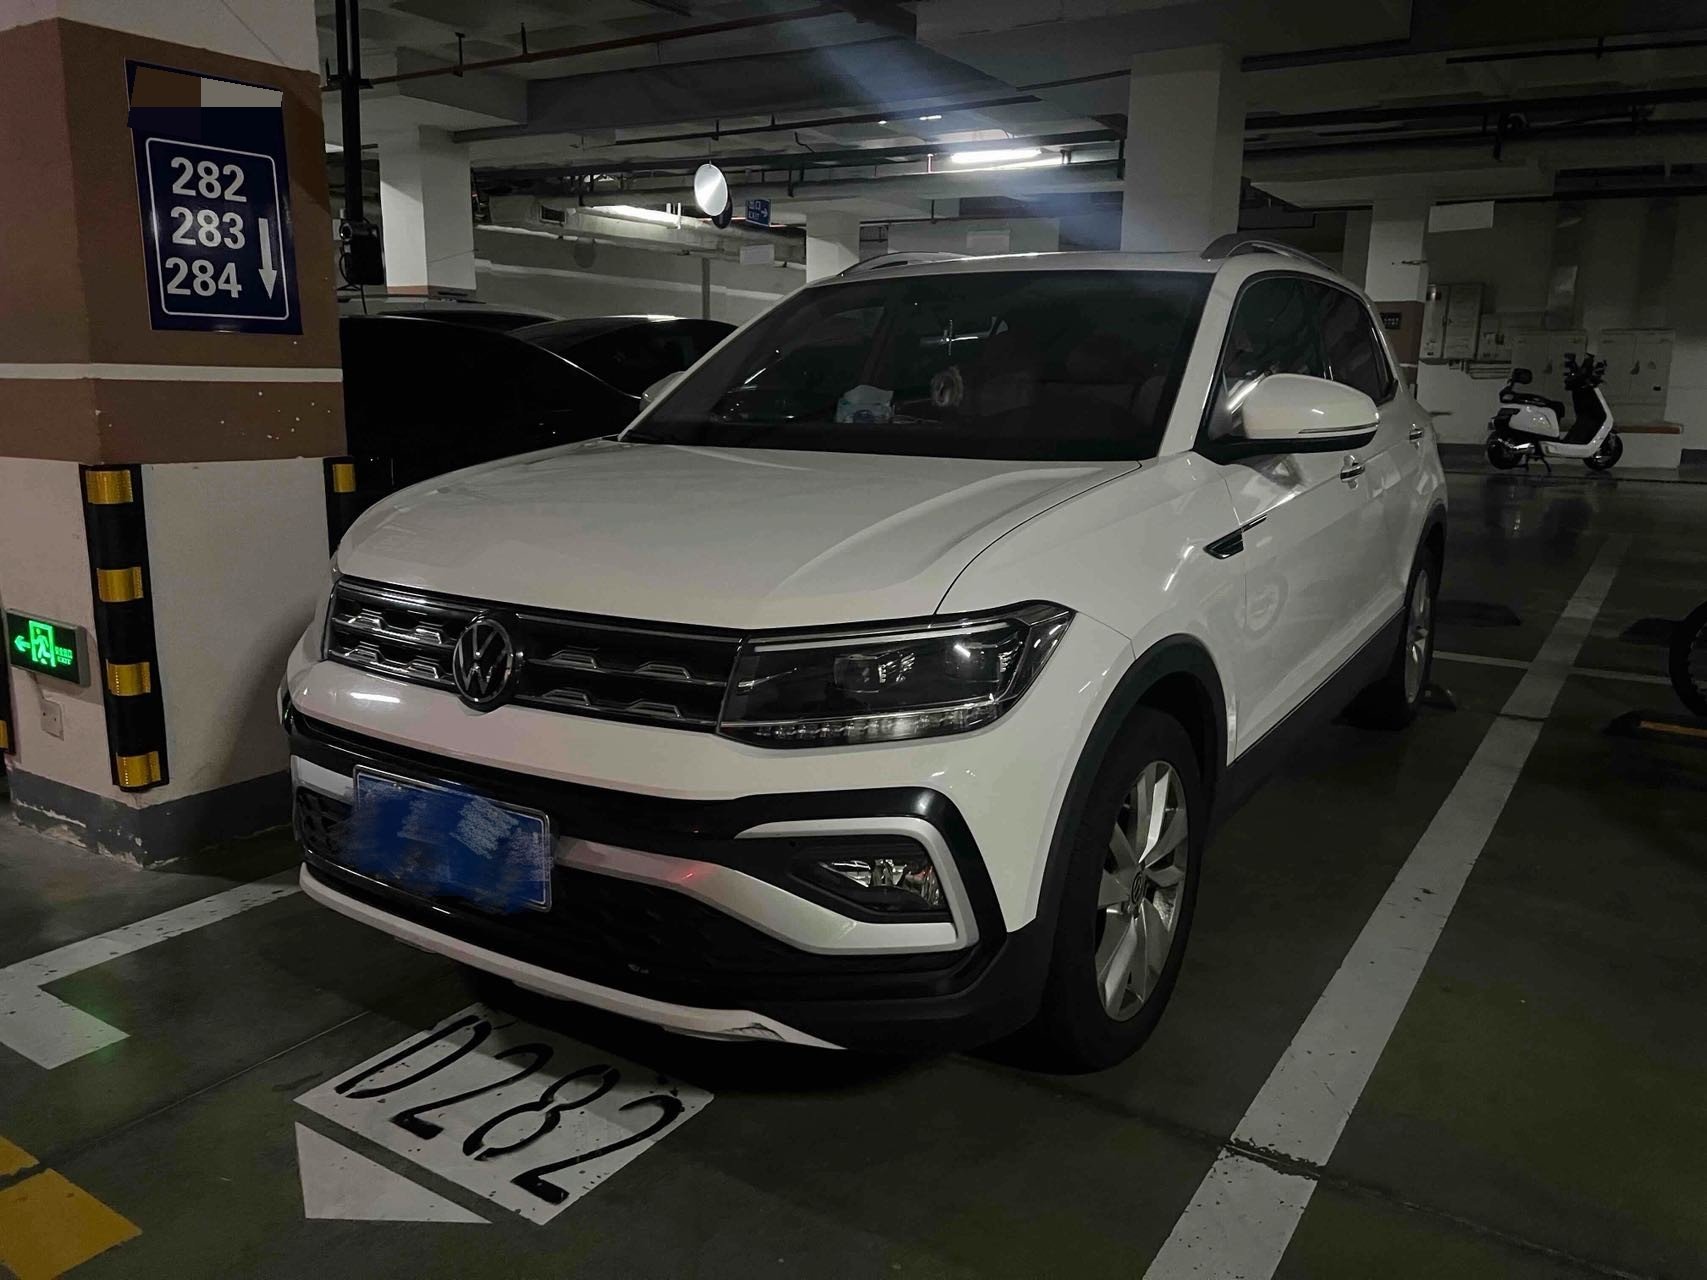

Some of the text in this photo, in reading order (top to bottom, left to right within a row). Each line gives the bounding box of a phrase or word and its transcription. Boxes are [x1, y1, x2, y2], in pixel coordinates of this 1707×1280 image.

[170, 156, 247, 203] 282
[170, 206, 246, 250] 283
[164, 256, 243, 299] 284
[334, 1014, 686, 1205] D282
